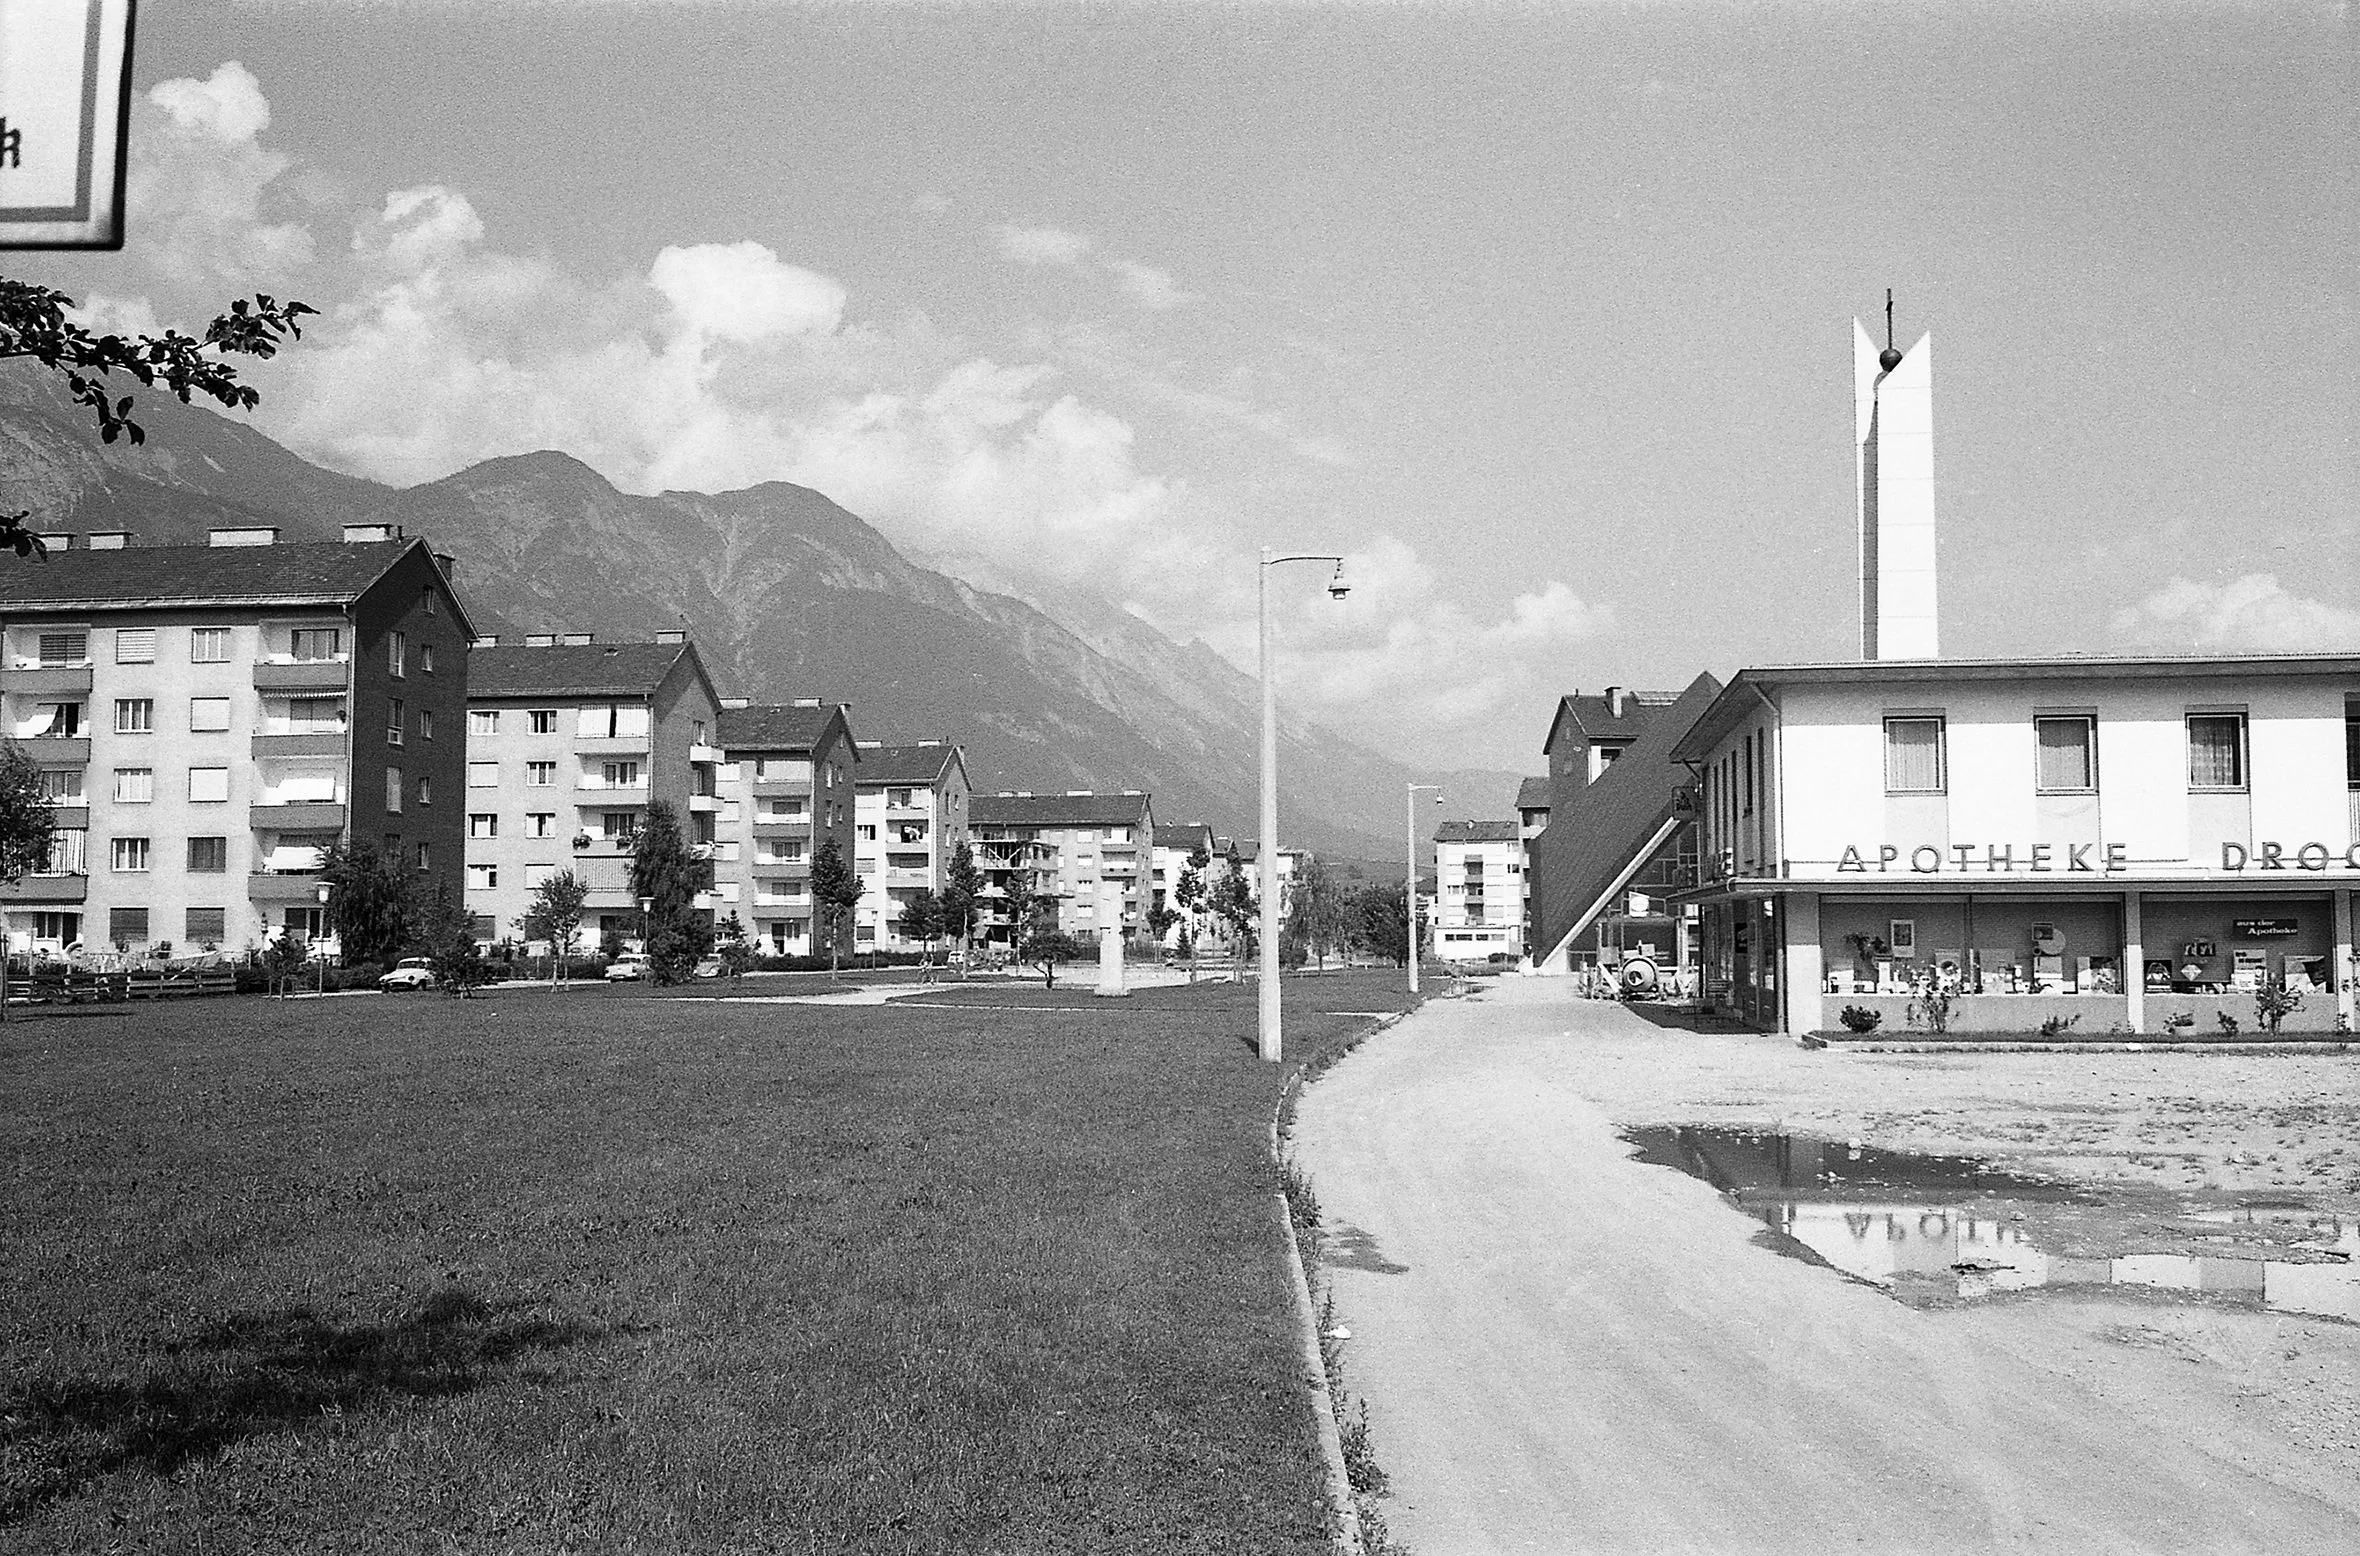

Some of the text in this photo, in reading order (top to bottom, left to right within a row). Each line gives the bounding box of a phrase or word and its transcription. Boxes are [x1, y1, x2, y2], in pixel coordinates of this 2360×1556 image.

[1836, 843, 2127, 873] APOTHEKE
[2257, 919, 2277, 927] der
[2247, 927, 2298, 936] Apotheke
